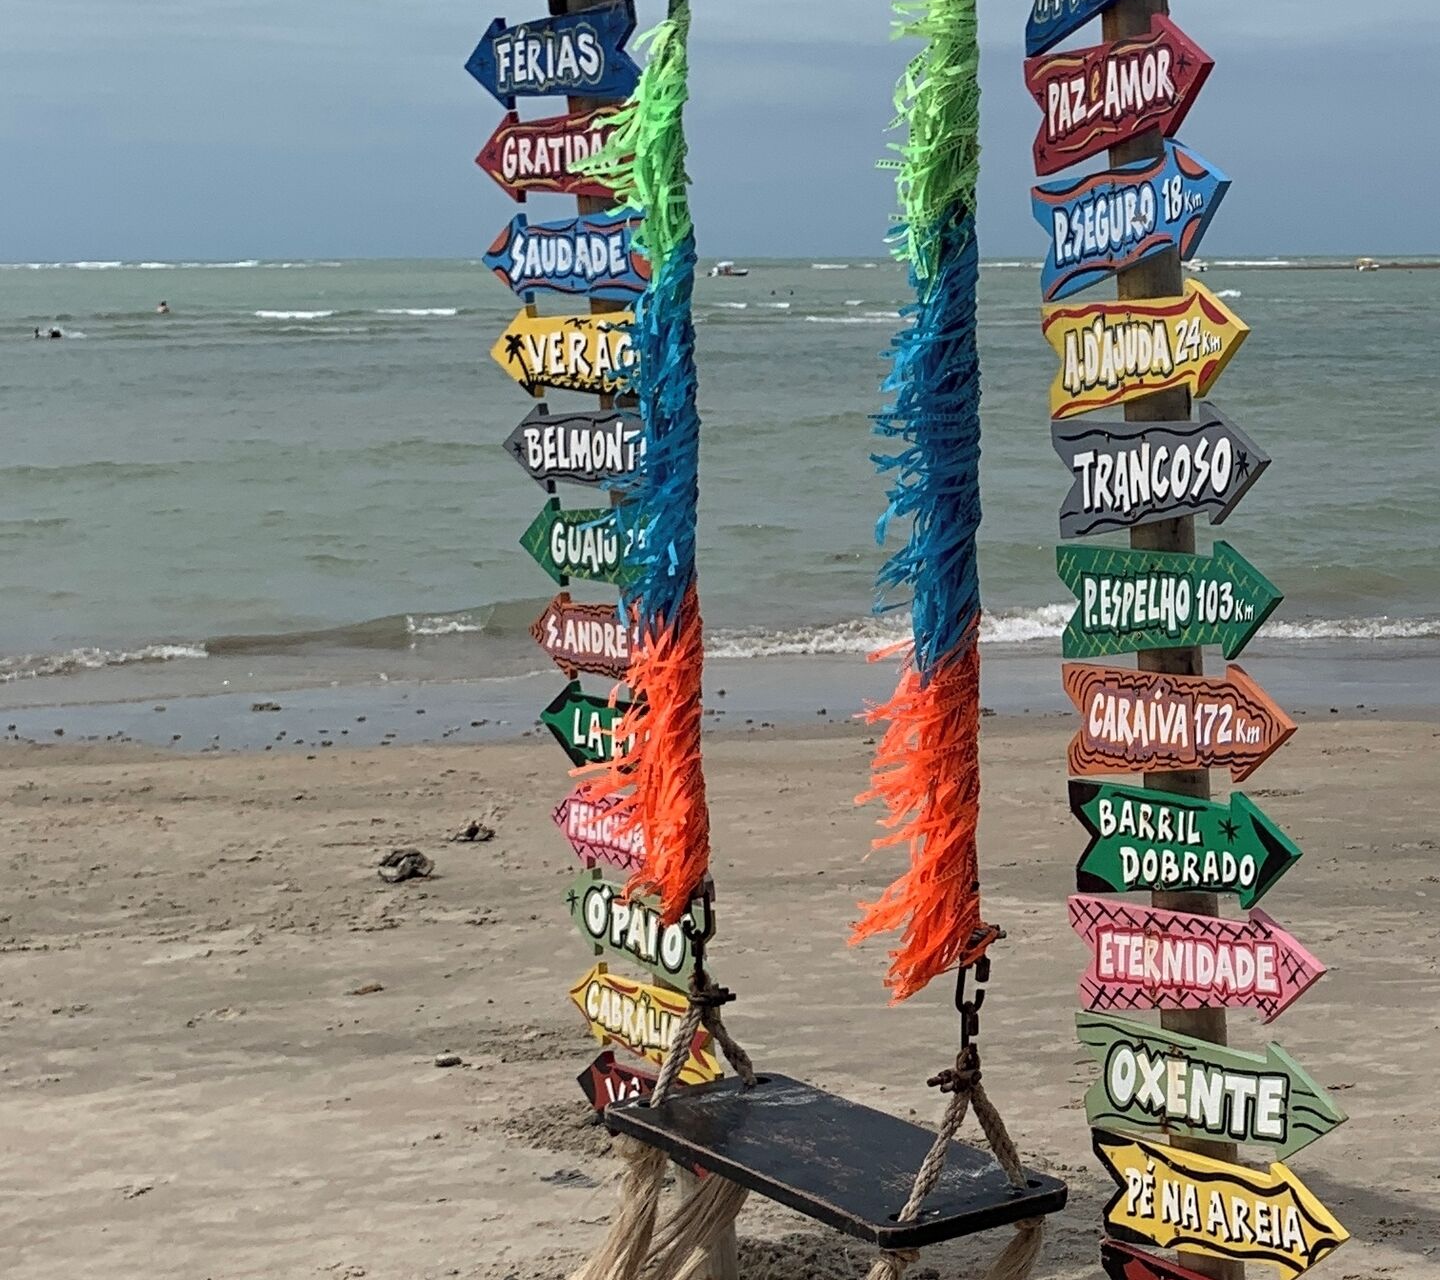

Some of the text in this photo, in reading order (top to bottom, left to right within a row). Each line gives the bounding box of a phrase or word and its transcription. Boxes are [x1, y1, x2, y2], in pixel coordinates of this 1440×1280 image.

[497, 28, 600, 86] FÉRIAS
[1047, 76, 1087, 138] PAZ
[1103, 48, 1175, 118] AMOR
[1162, 174, 1184, 222] 18
[510, 231, 628, 280] SAUDADE
[1174, 316, 1201, 365] 24
[1073, 436, 1233, 514] TRANCOSO
[1084, 577, 1191, 632] P.ESPELHO
[1196, 578, 1234, 624] 103
[573, 706, 605, 757] LA
[1088, 686, 1189, 747] CARAÍVA
[1193, 702, 1233, 746] 172
[1099, 798, 1201, 844] BARRIL
[1119, 846, 1256, 887] DOBRADO
[1100, 929, 1278, 994] ETERNIDADE
[1111, 1048, 1284, 1136] OXENTE
[1125, 1159, 1307, 1254] PÉ NA AREIA
